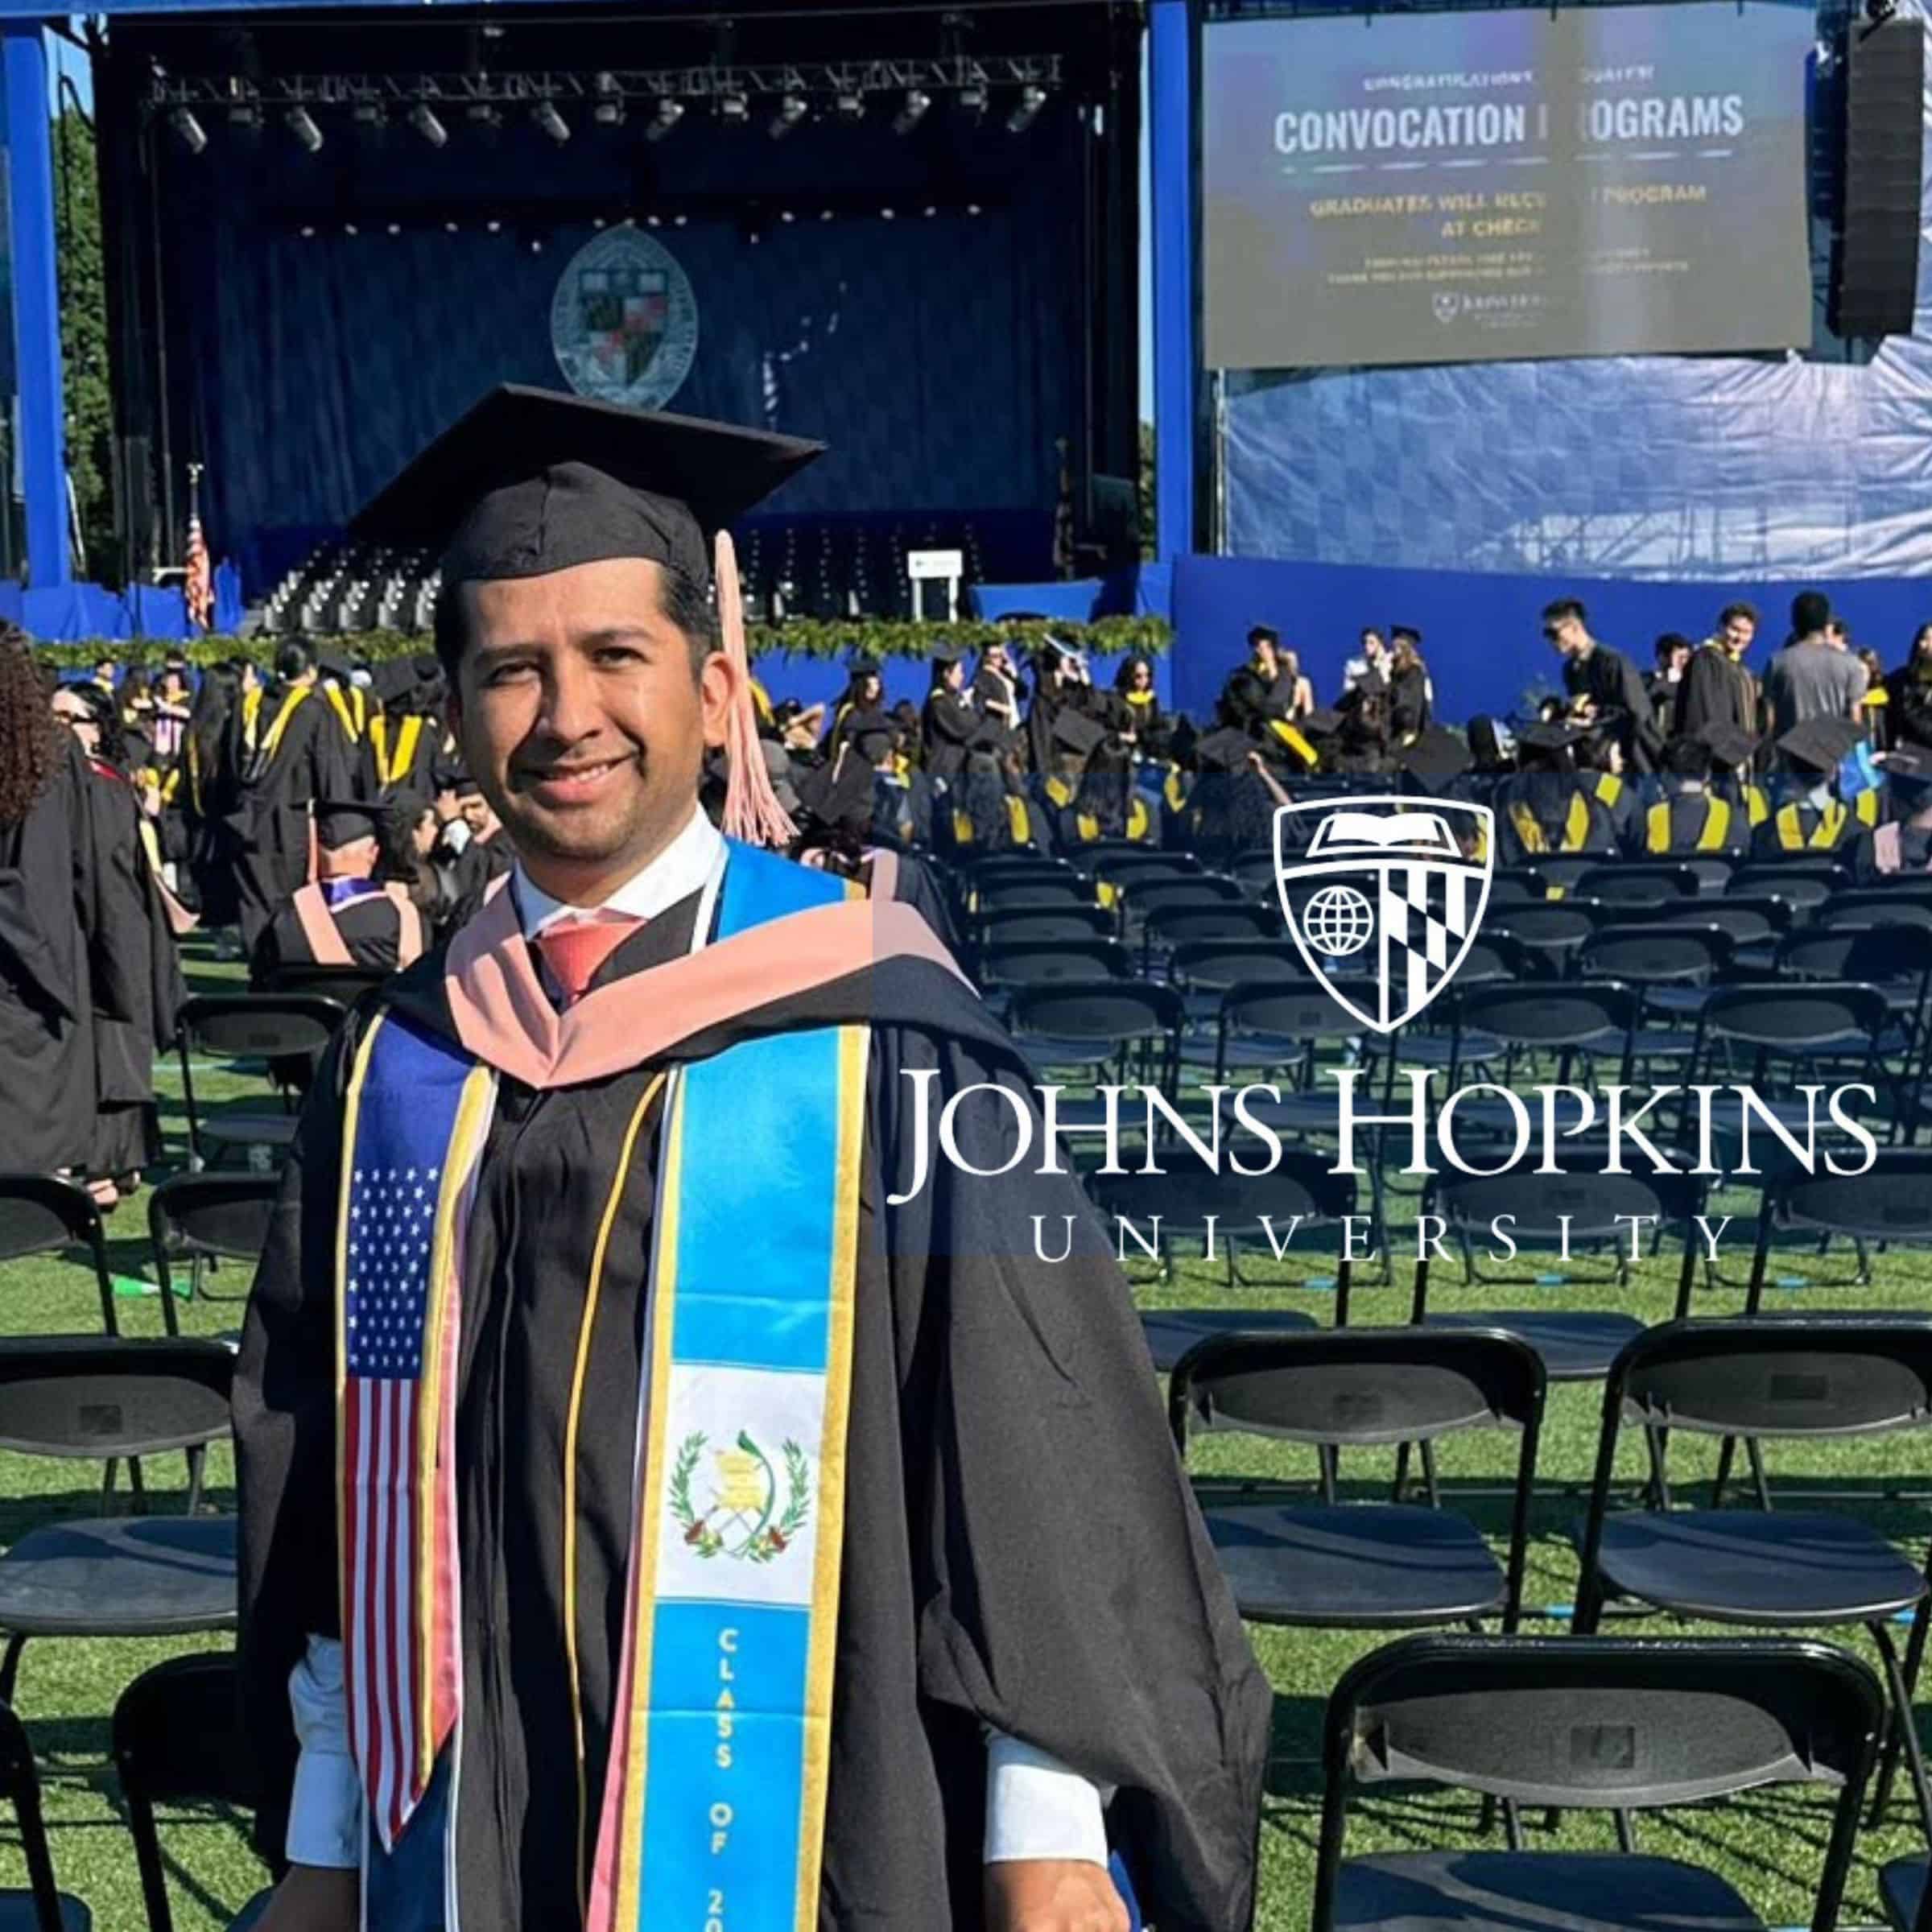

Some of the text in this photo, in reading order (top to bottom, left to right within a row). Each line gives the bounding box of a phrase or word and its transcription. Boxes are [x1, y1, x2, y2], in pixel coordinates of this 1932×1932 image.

[1274, 103, 1526, 154] CONVOCATION
[1309, 193, 1432, 218] GRADUATES
[1438, 192, 1486, 212] WILL
[1442, 219, 1467, 238] AT
[716, 1628, 739, 1769] CLASS
[708, 1802, 733, 1856] OF
